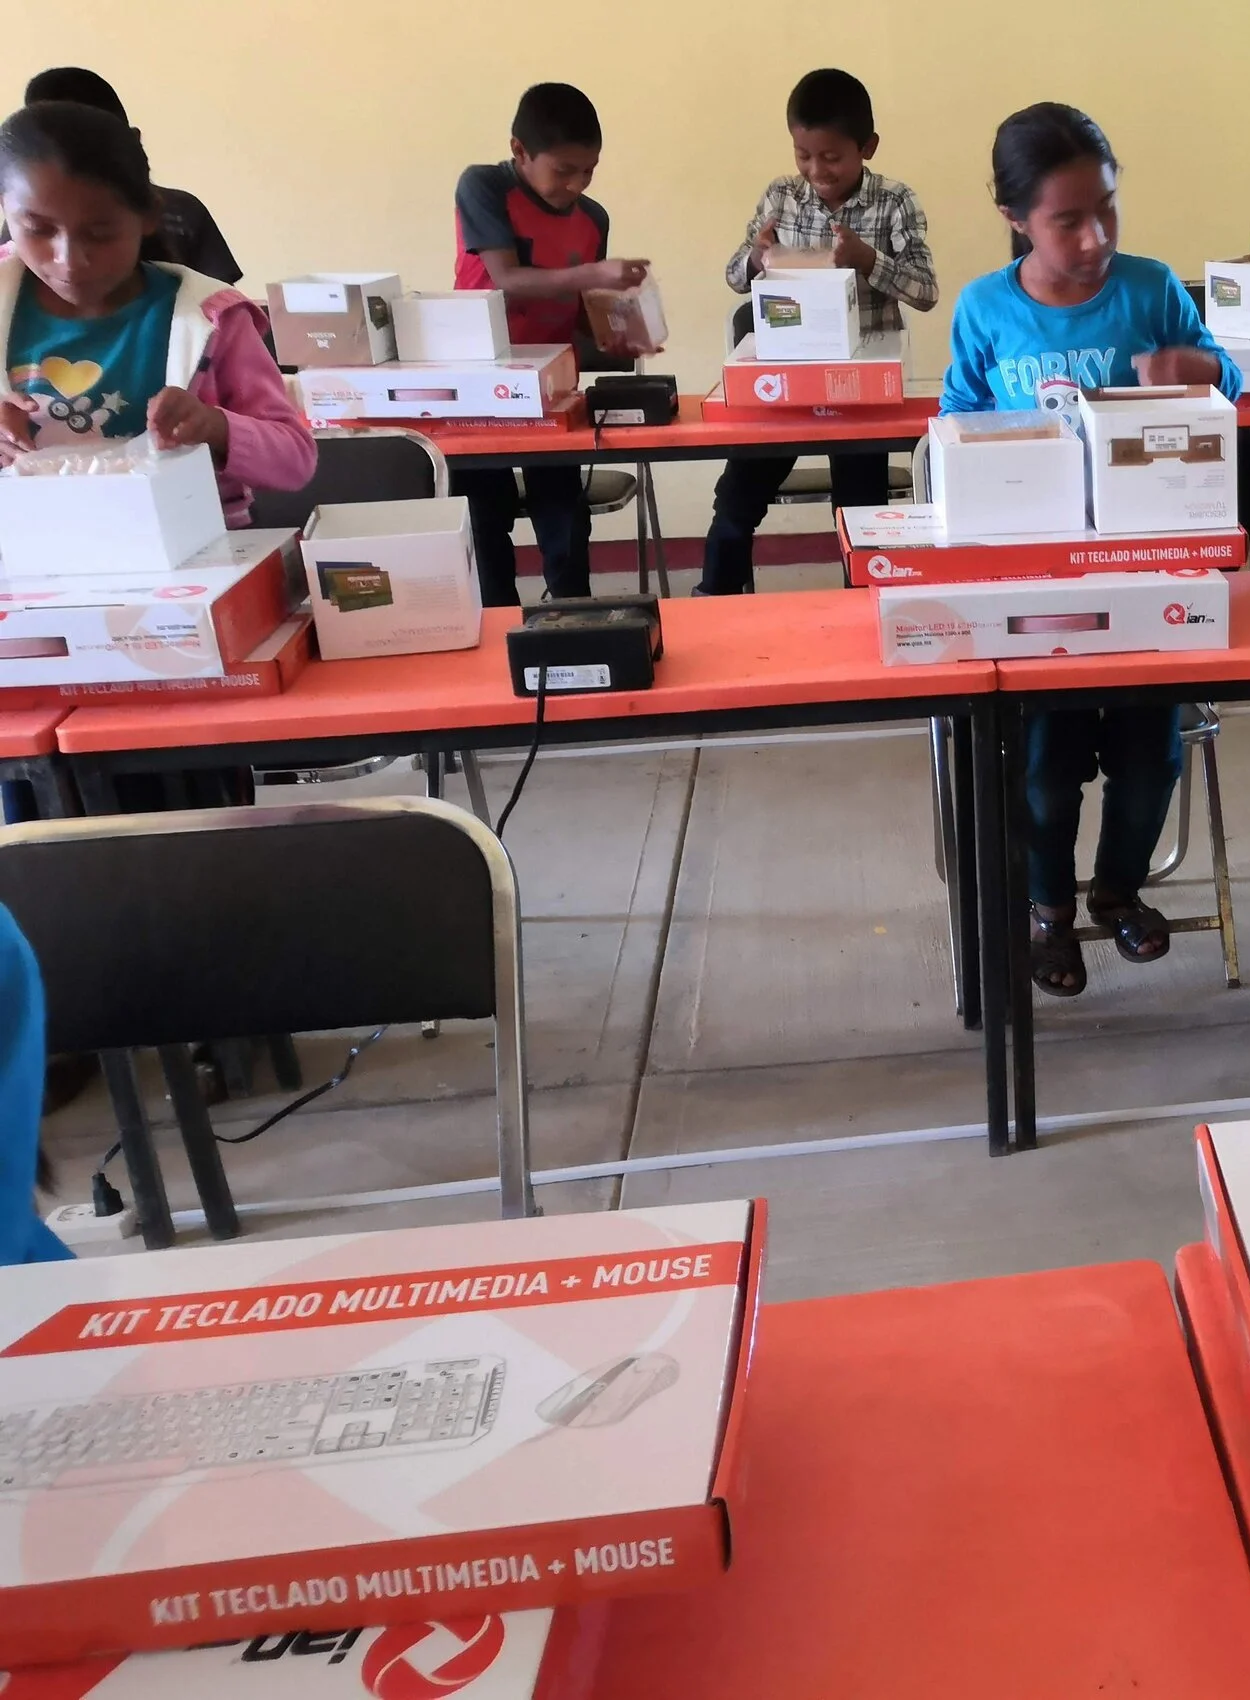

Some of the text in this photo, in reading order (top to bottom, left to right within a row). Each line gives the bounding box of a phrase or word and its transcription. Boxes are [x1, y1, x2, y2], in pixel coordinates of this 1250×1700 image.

[999, 347, 1116, 398] FORKY
[1069, 551, 1085, 565] KIT
[1087, 549, 1130, 563] TECLADO
[1132, 547, 1190, 562] MULTIMEDIA
[1200, 545, 1233, 559] MOUSE
[220, 673, 260, 688] MOUSE
[78, 1254, 712, 1340] KIT TECLADO MULTIMEDIA + MOUSE
[150, 1536, 675, 1627] KIT TECLADO MULTIMEDIA + MOUSE
